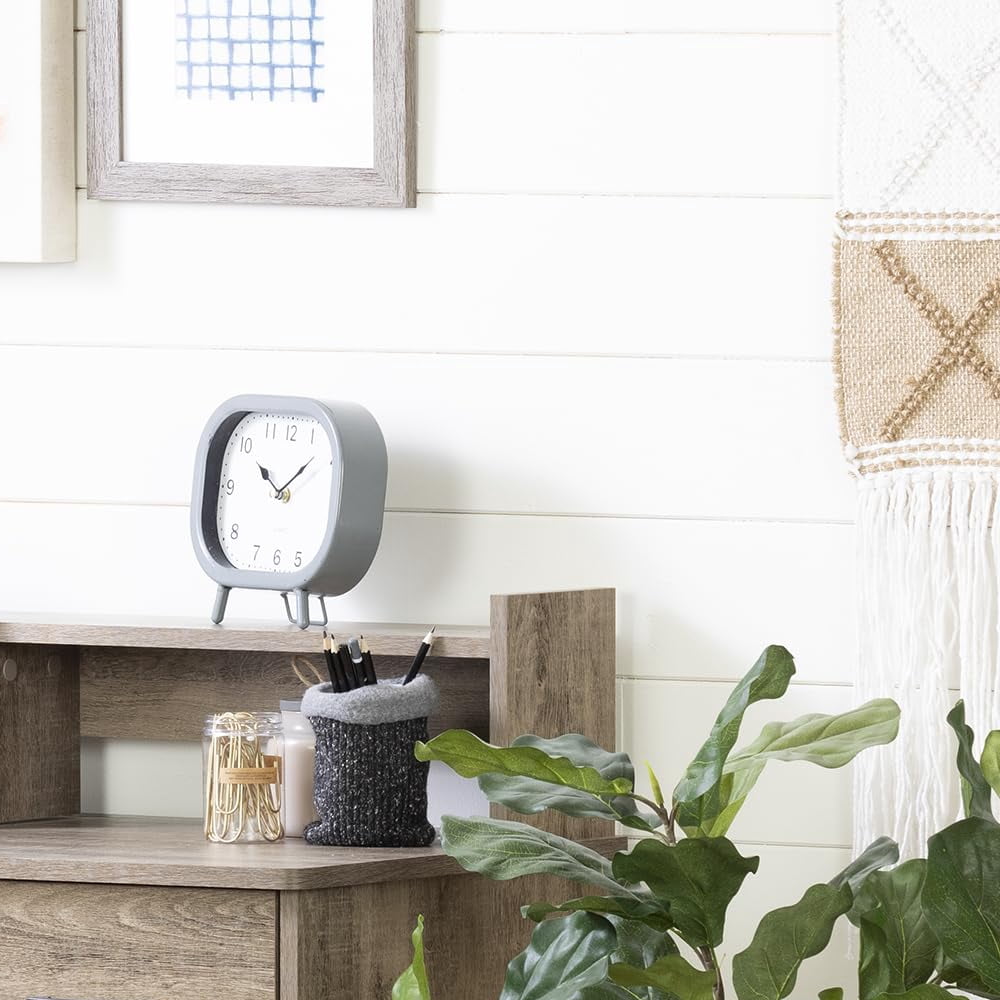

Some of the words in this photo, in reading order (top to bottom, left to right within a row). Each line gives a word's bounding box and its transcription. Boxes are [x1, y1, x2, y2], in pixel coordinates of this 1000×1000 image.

[265, 423, 276, 440] 11
[285, 425, 298, 442] 12
[240, 436, 253, 454] 10
[226, 479, 235, 496] 9
[230, 523, 239, 540] 8
[253, 545, 261, 561] 7
[273, 550, 281, 566] 6
[294, 552, 302, 567] 5
